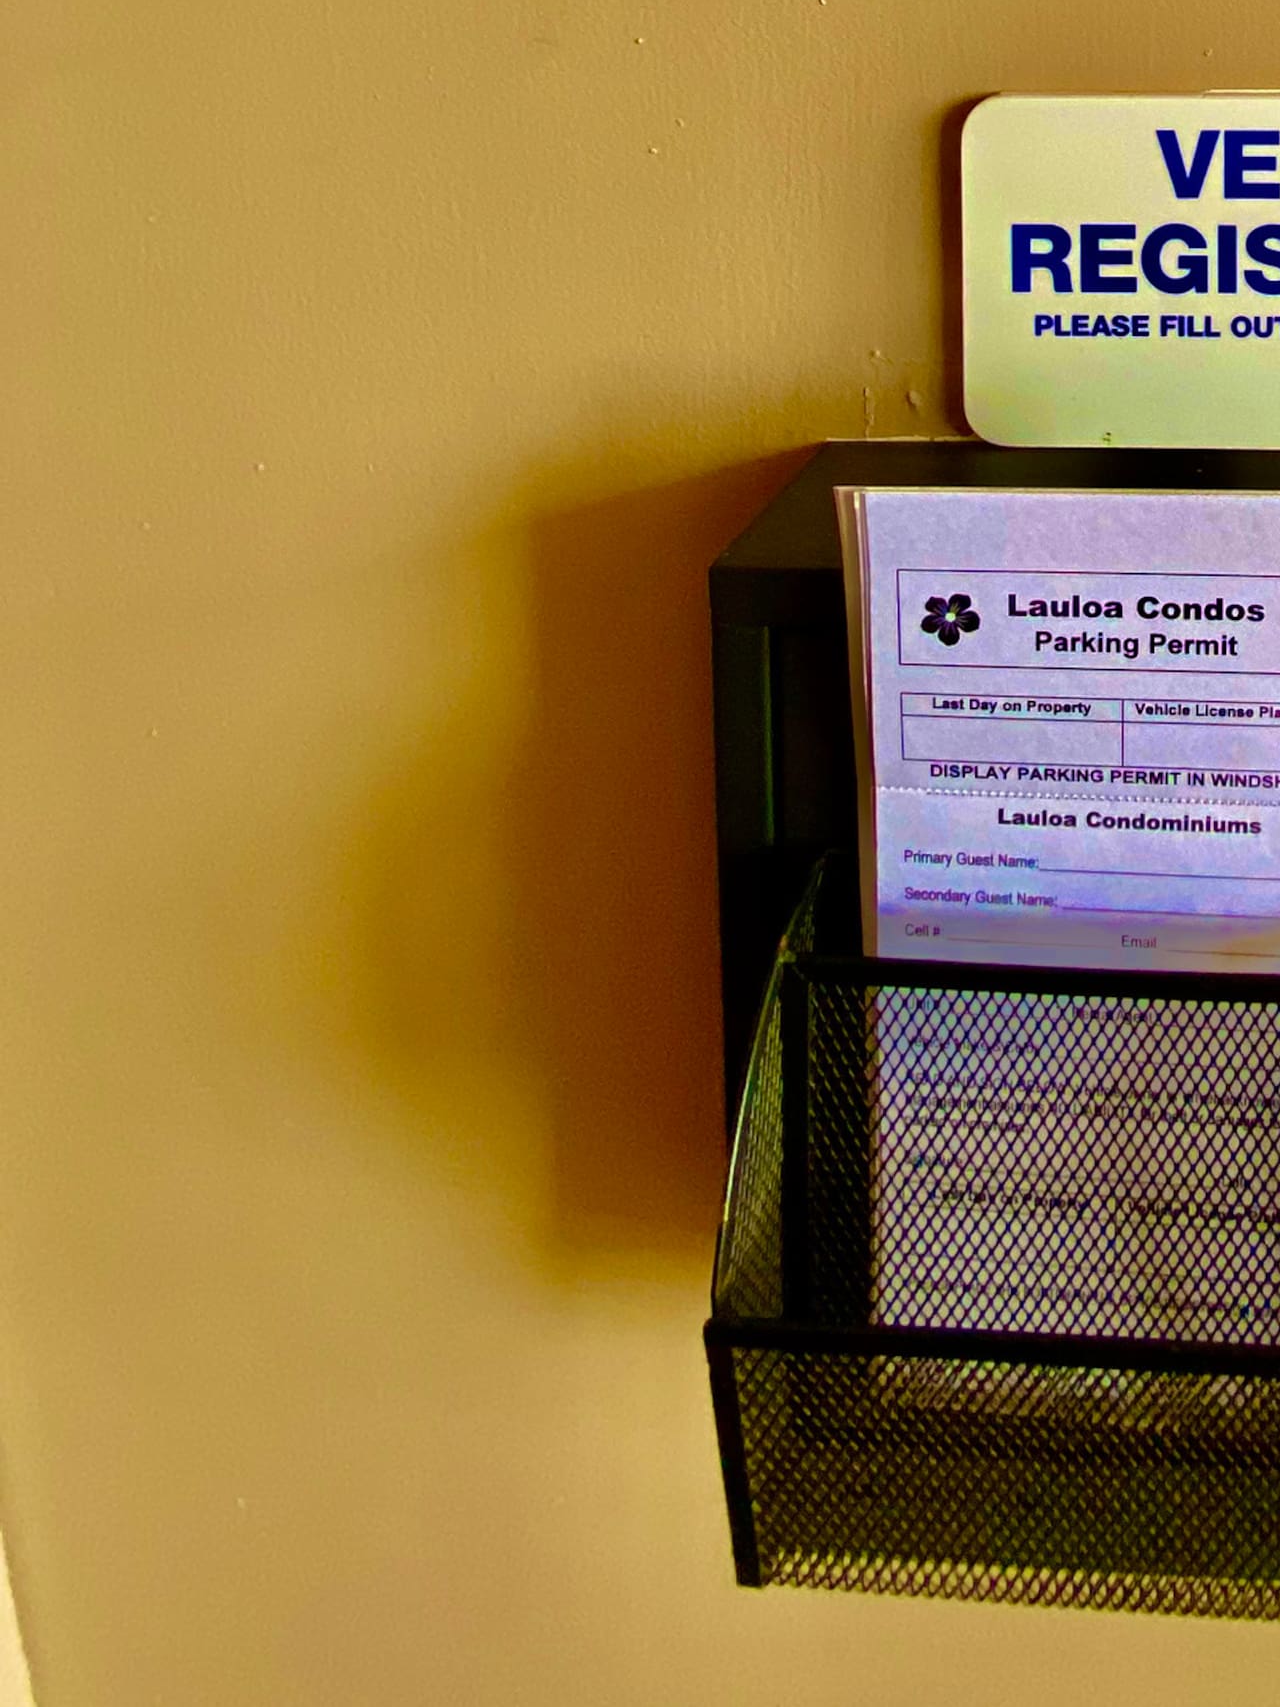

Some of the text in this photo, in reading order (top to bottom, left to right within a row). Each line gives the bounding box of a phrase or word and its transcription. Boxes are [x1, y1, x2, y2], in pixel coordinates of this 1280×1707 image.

[1034, 314, 1150, 339] PLEASE
[1160, 315, 1221, 338] FILL
[1008, 594, 1265, 622] Lauloa Condos
[1035, 631, 1238, 659] Parking Permit
[932, 696, 1091, 717] Last Day on Property
[1135, 702, 1190, 717] Vehicle
[1195, 704, 1254, 718] License
[930, 763, 1011, 780] DISPLAY
[1017, 766, 1105, 783] PARKING
[1110, 768, 1181, 785] PERMIT
[1187, 770, 1207, 787] IN
[998, 808, 1262, 835] Lauloa Condominiums
[904, 849, 1039, 870] Primary Guest Name:
[904, 887, 1058, 908] Secondary Guest Name:
[905, 923, 929, 937] Cell
[1121, 934, 1156, 948] Email
